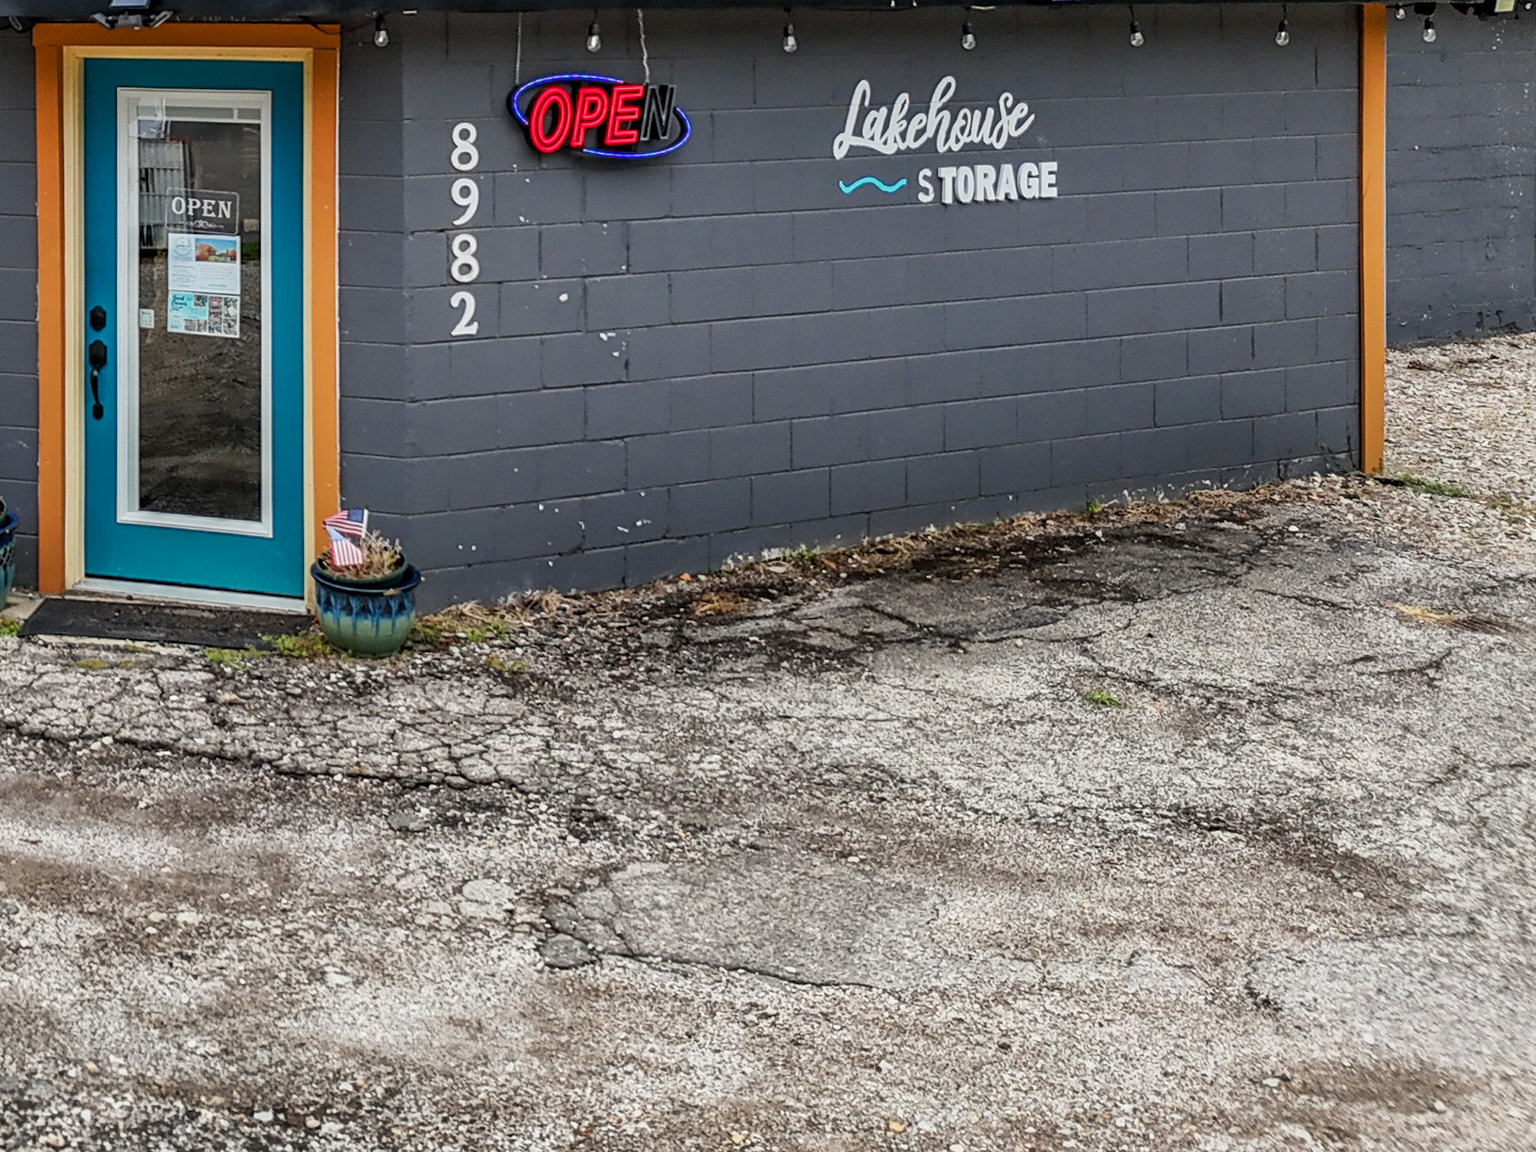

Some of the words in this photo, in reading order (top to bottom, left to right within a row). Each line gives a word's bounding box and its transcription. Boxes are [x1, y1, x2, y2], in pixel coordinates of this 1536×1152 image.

[529, 85, 678, 154] OPEN
[833, 75, 1035, 161] Lakehouse
[171, 196, 233, 219] OPEN
[916, 160, 1059, 205] STORAGE
[449, 121, 480, 337] 8982
